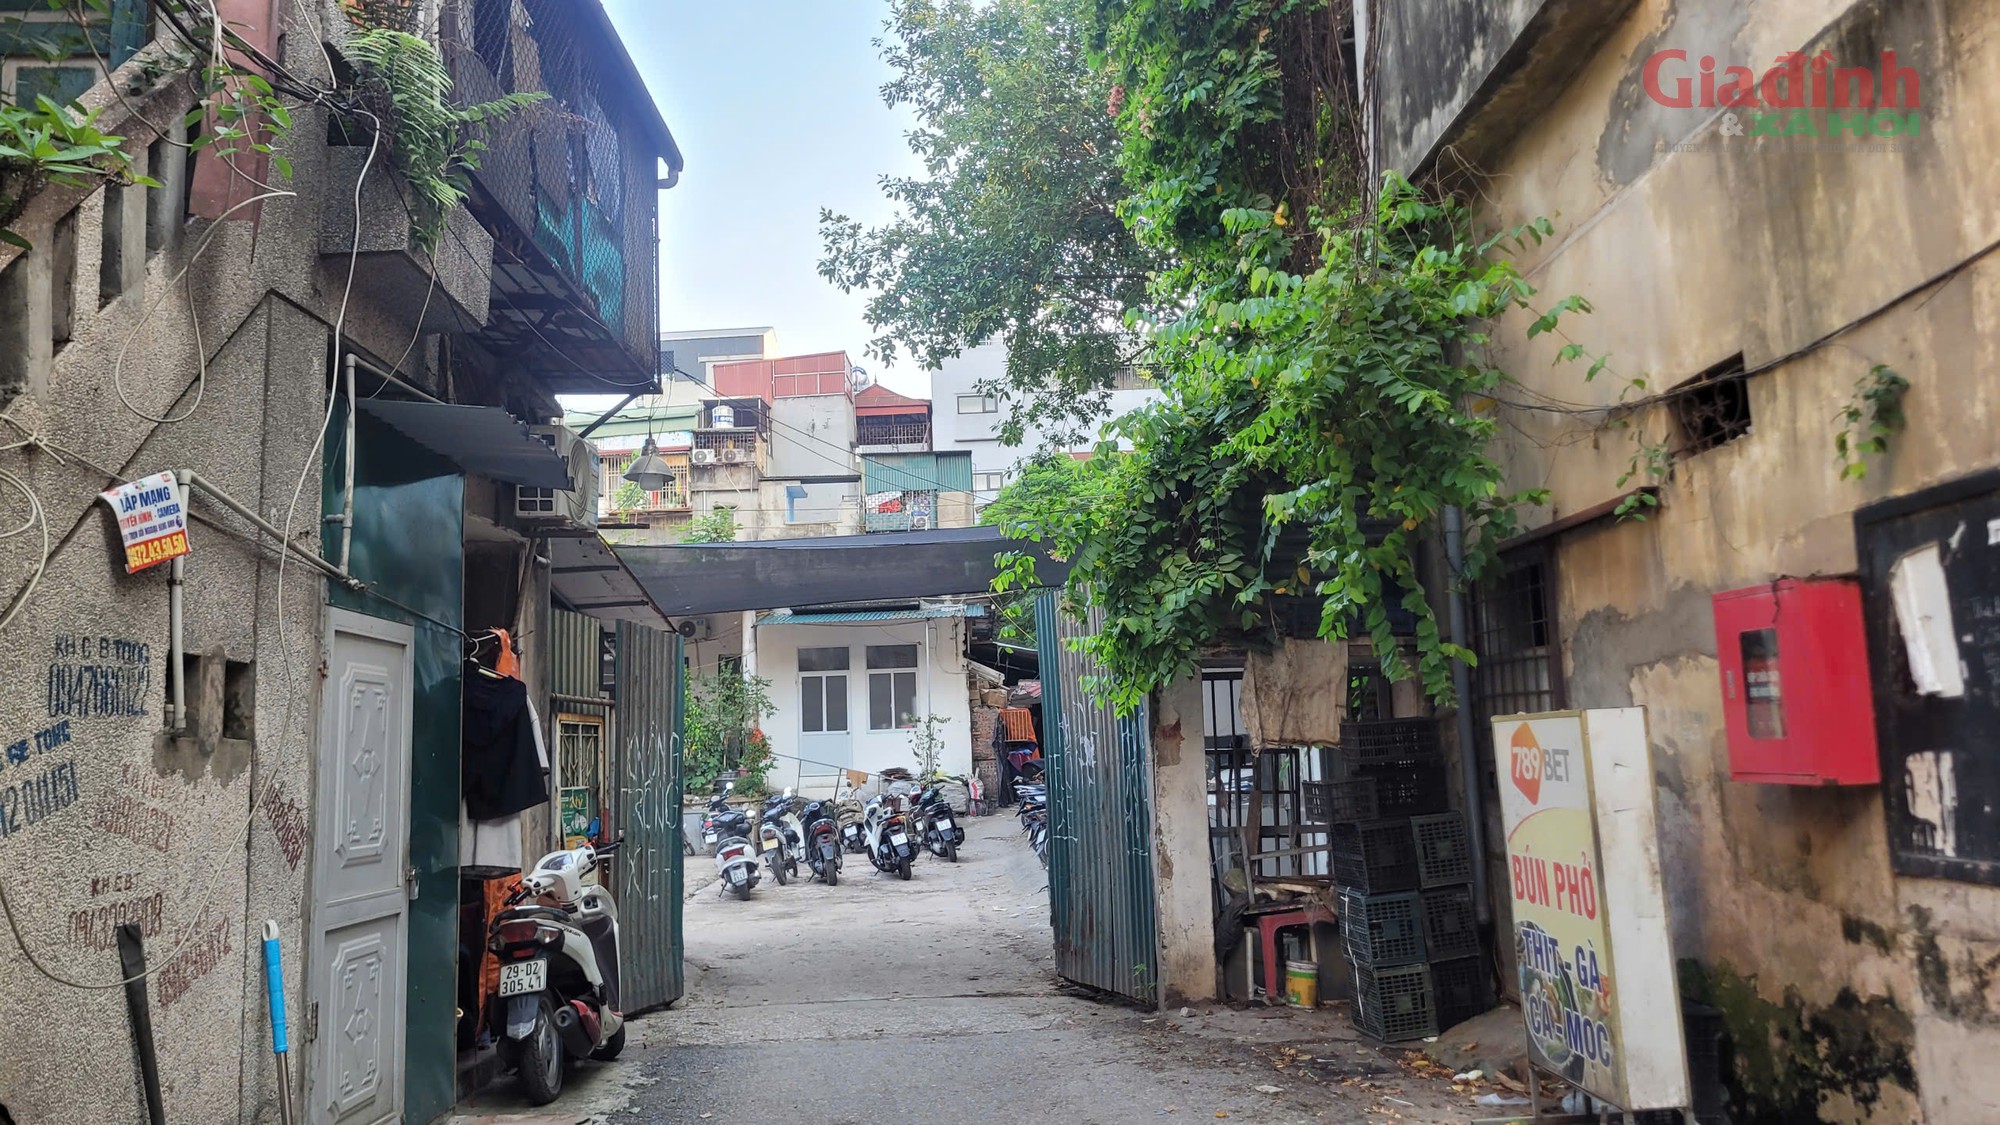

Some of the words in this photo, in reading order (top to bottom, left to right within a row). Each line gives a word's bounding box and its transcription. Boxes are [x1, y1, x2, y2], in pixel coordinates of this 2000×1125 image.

[139, 486, 170, 507] MẠNG
[1511, 845, 1551, 909] BÚN
[1552, 851, 1597, 920] PHỞ
[506, 962, 539, 980] 29-D2
[1522, 928, 1561, 983] THỊT
[1574, 939, 1603, 993] GÀ
[1528, 986, 1554, 1040] CÁ
[1564, 1010, 1611, 1070] MỌC
